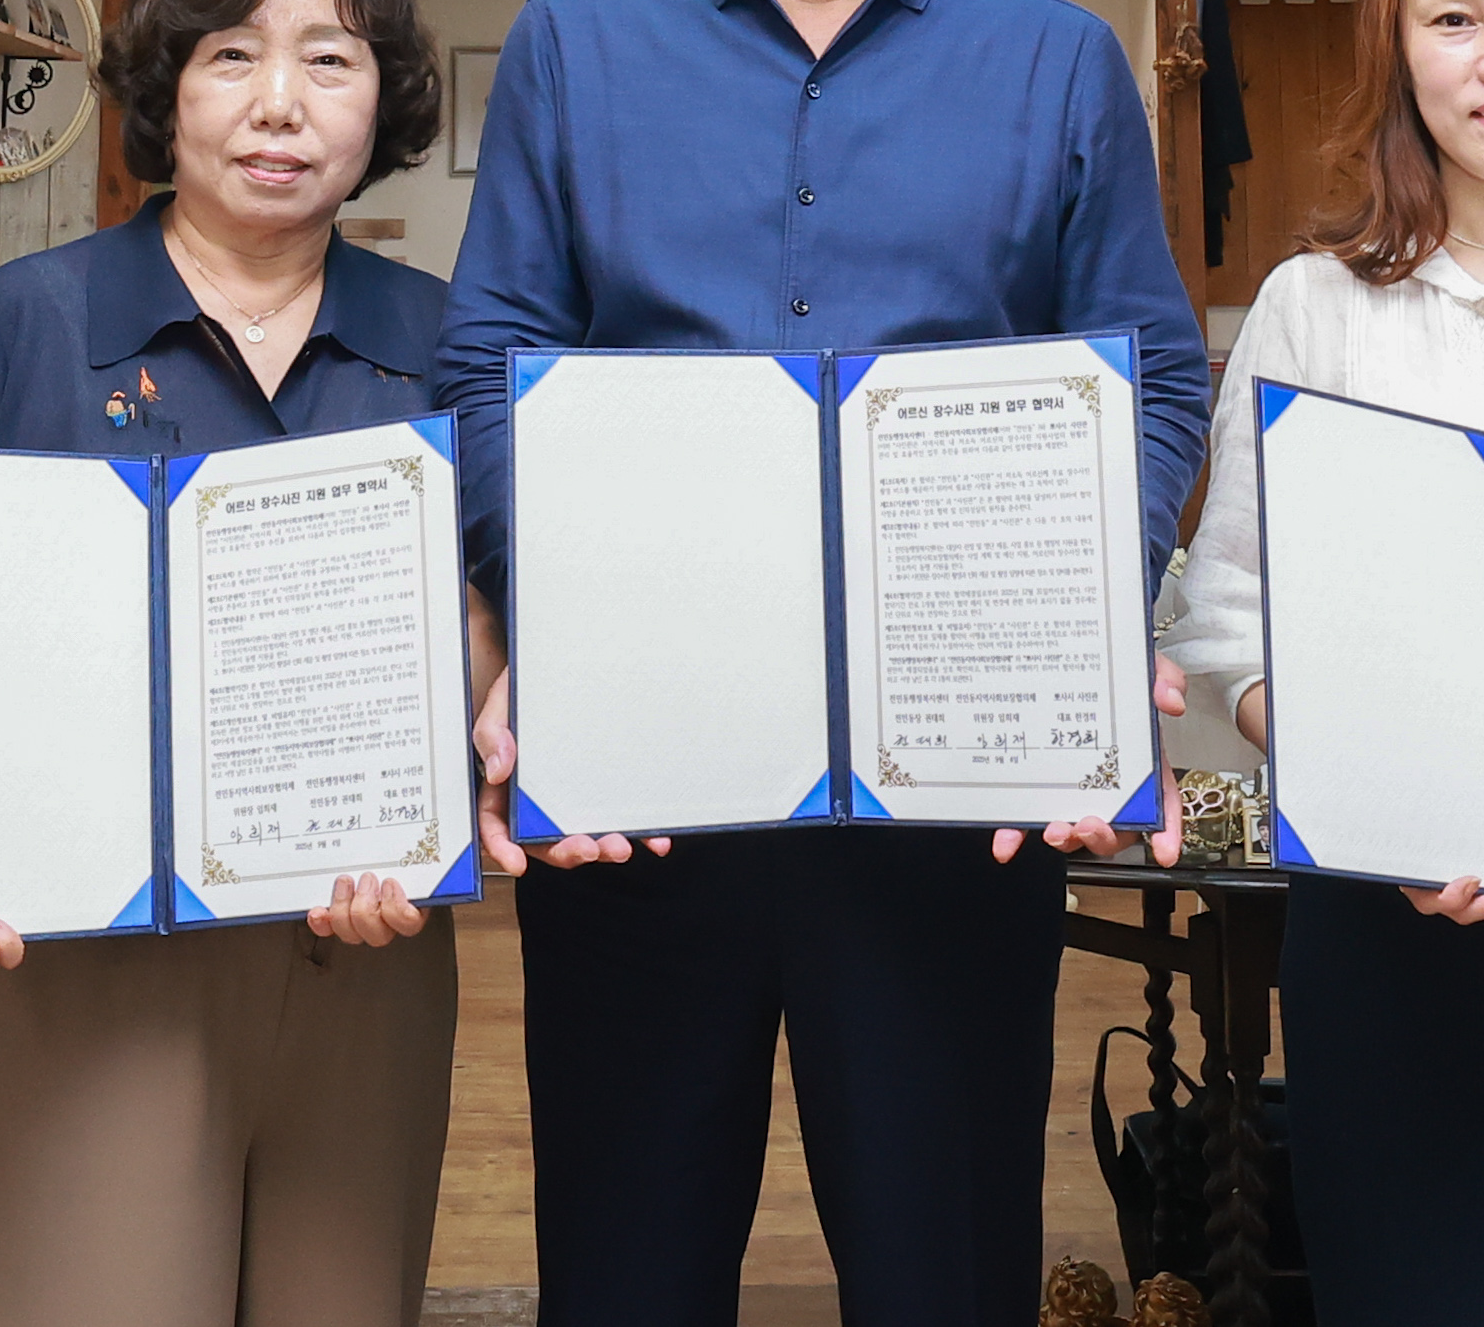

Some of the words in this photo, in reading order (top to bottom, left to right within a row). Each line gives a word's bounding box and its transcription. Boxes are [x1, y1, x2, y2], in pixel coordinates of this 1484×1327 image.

[897, 406, 928, 420] 어르신
[934, 402, 975, 418] 장수사진
[980, 400, 1001, 414] 지원
[1006, 398, 1027, 413] 업무
[1032, 396, 1065, 411] 협약서
[225, 498, 256, 515] 어르신
[261, 493, 301, 510] 장수사진
[306, 489, 326, 503] 지원
[331, 484, 352, 499] 업무
[357, 479, 388, 496] 협약서
